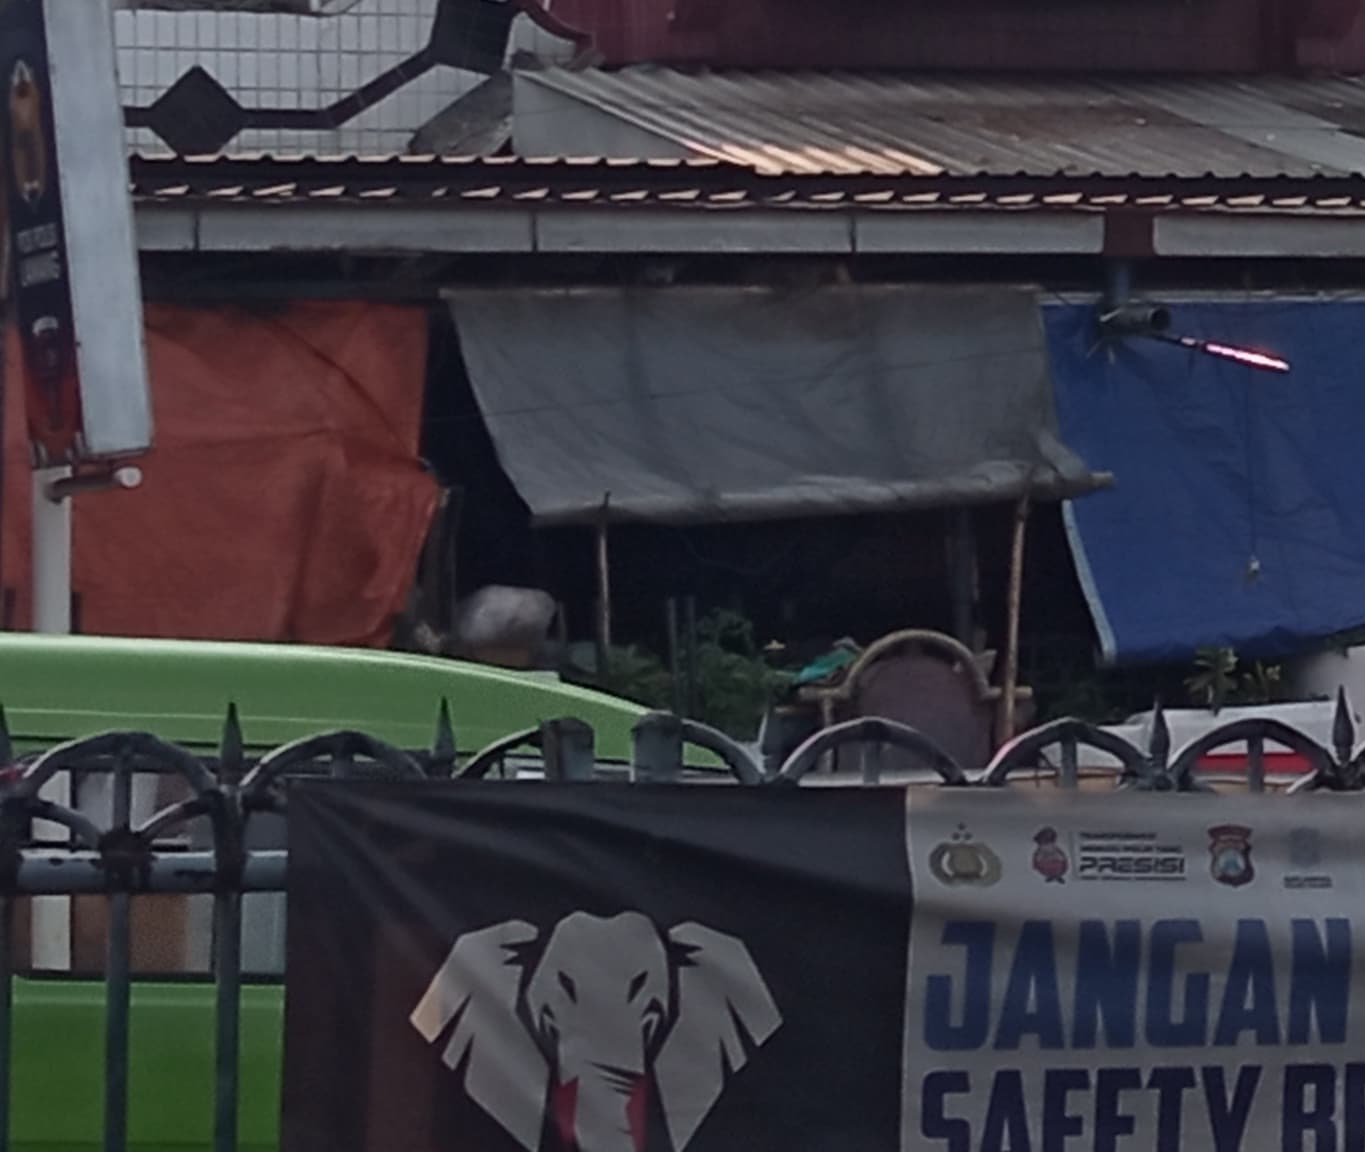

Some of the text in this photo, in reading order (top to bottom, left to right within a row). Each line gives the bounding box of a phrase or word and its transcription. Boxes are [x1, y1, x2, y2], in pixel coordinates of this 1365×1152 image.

[1079, 856, 1185, 874] PRESISI
[923, 918, 1352, 1051] JANGAN
[921, 1064, 1262, 1152] SAFETY
